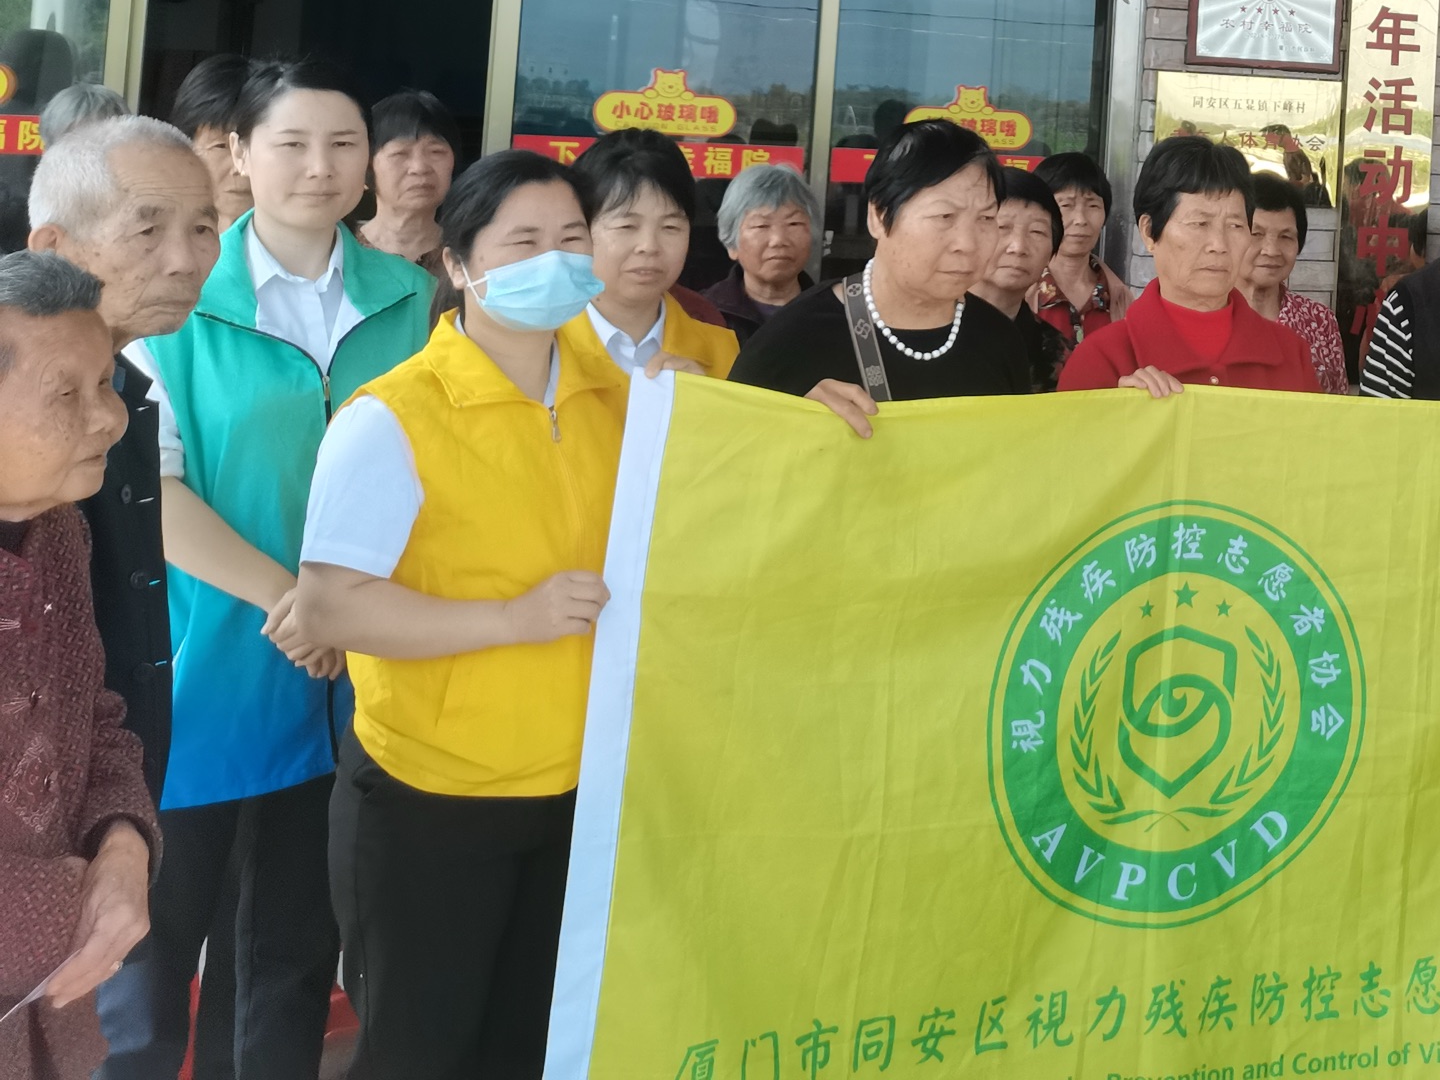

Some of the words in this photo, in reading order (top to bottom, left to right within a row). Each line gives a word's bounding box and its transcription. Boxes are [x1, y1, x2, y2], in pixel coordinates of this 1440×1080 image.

[1220, 19, 1312, 34] 农村幸福院
[612, 100, 719, 124] 小心玻璃哦
[1192, 96, 1305, 114] 同安区五显镇下峰村
[0, 120, 45, 150] 院
[1031, 810, 1289, 901] AVPCVD
[1242, 1054, 1284, 1078] and
[1292, 1046, 1379, 1075] Control
[1387, 1042, 1411, 1066] of
